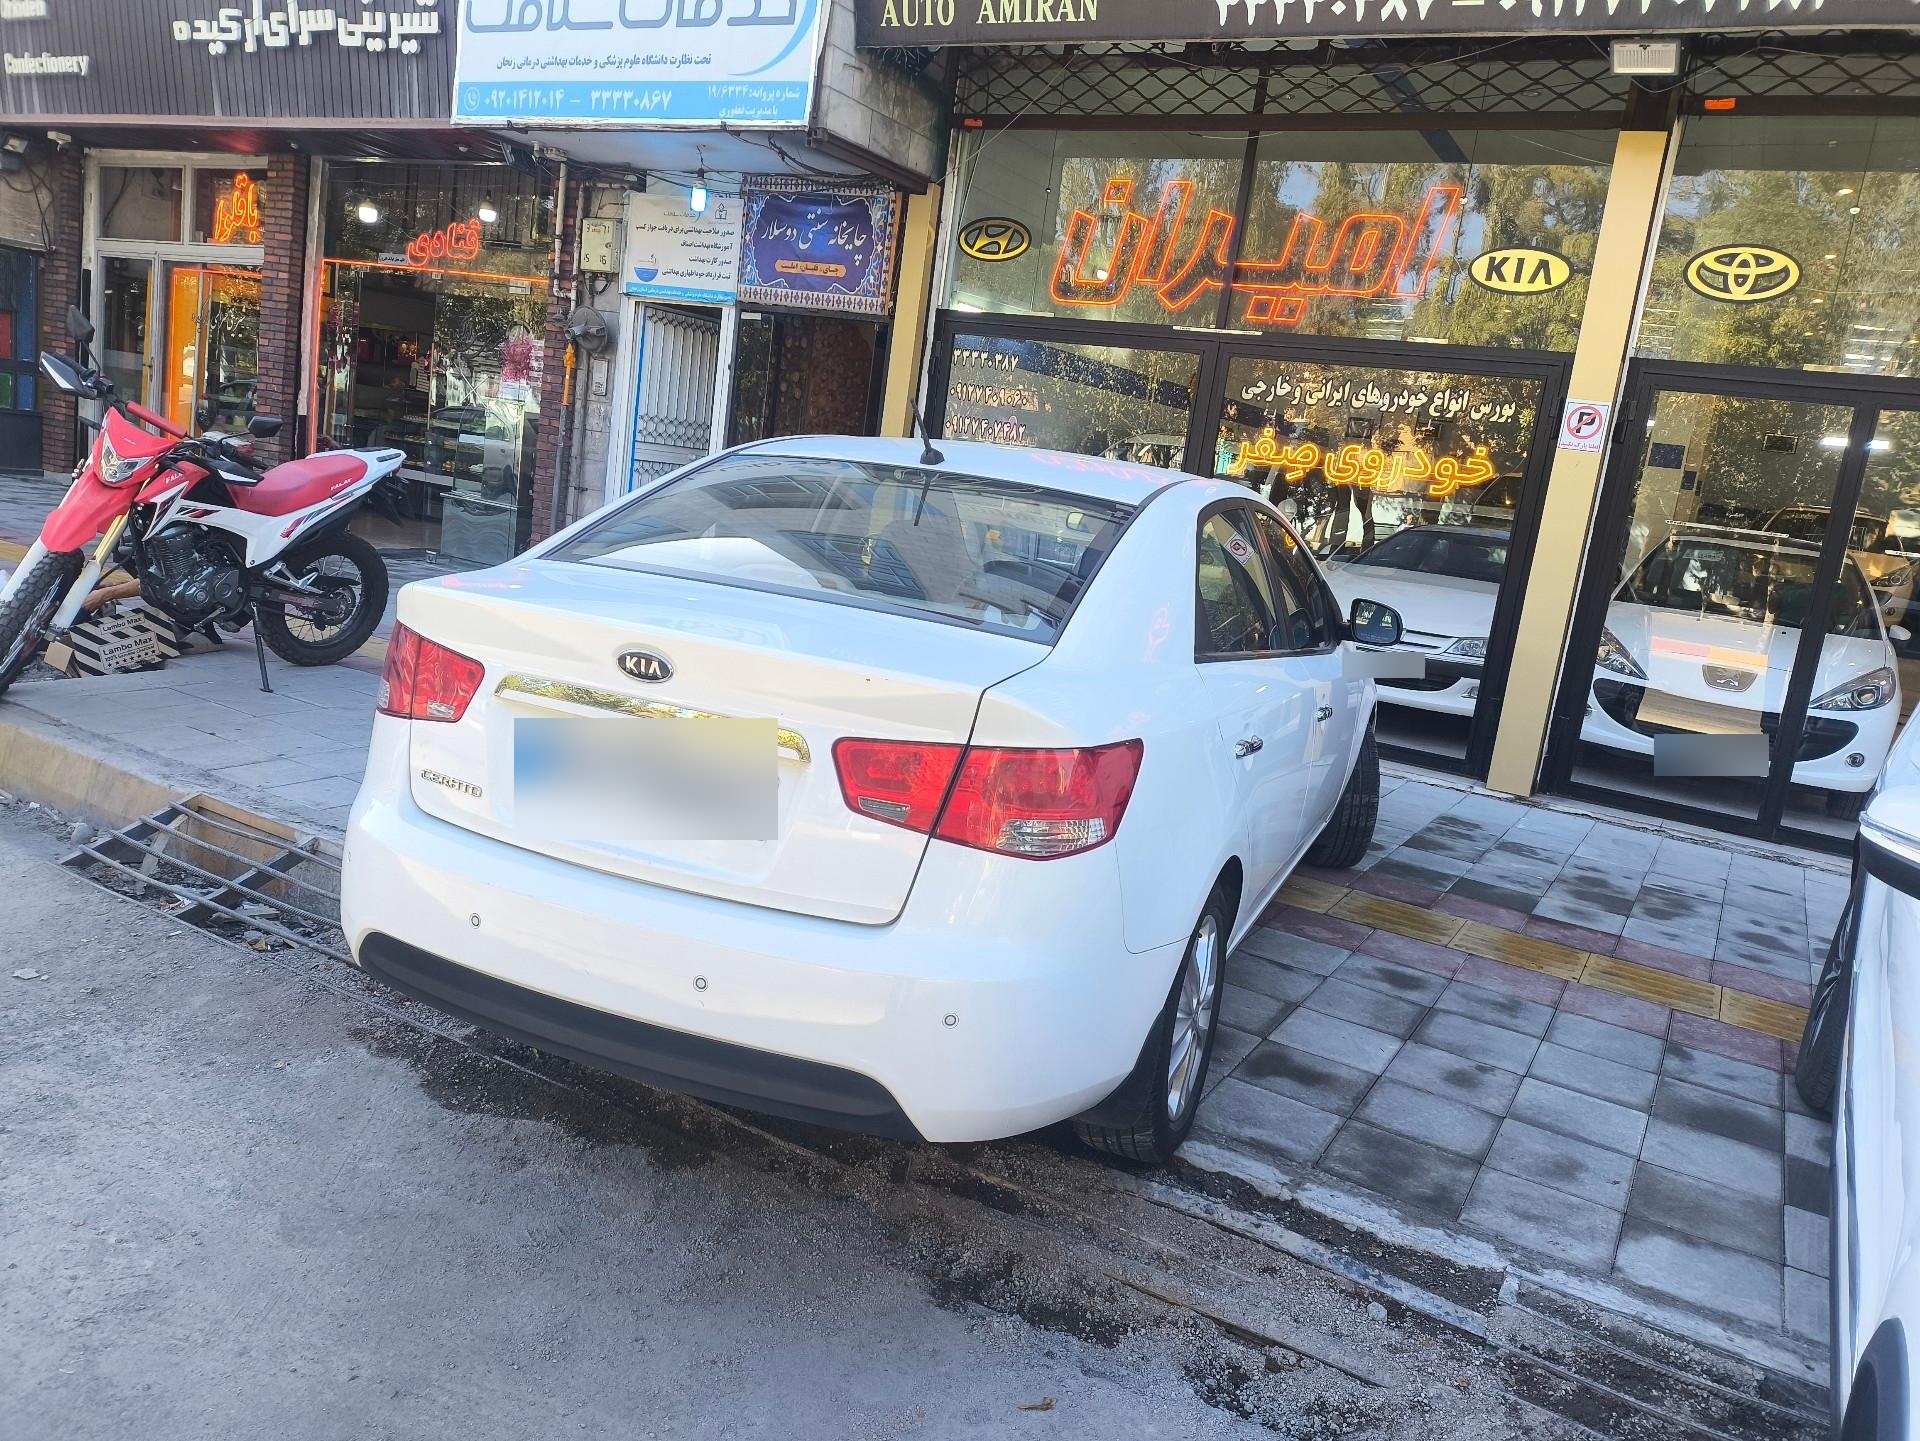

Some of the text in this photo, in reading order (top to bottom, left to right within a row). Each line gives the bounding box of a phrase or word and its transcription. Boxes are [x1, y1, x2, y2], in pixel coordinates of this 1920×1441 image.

[880, 0, 1099, 27] AUTO AMIRAN
[172, 0, 442, 56] شیرینی سرای ارکیده
[3, 51, 90, 77] Confectionery
[496, 56, 516, 70] زنجان
[516, 56, 540, 70] درمانی
[540, 56, 568, 70] بهداشتی
[568, 56, 593, 67] خدمات
[599, 54, 623, 69] پزشکی
[623, 54, 641, 69] علوم
[641, 54, 668, 65] دانشگاه
[669, 54, 693, 69] نظارت
[694, 53, 713, 65] تحت
[213, 173, 259, 243] باقلوا
[798, 207, 829, 250] سنتی
[406, 217, 482, 267] قنادی
[827, 220, 868, 267] چایخانه
[1050, 178, 1463, 322] امیران
[1484, 255, 1552, 286] KIA
[953, 348, 1019, 372] ۳۳۳۳۰۳۸۷
[1241, 374, 1517, 423] بورس انواع خودروهای ایرانی و خارجی
[1325, 446, 1498, 496] خودروی
[102, 617, 142, 632] Lambo Max
[102, 636, 153, 656] Lambo Max
[625, 654, 662, 679] KIA
[420, 768, 483, 798] CERATO
